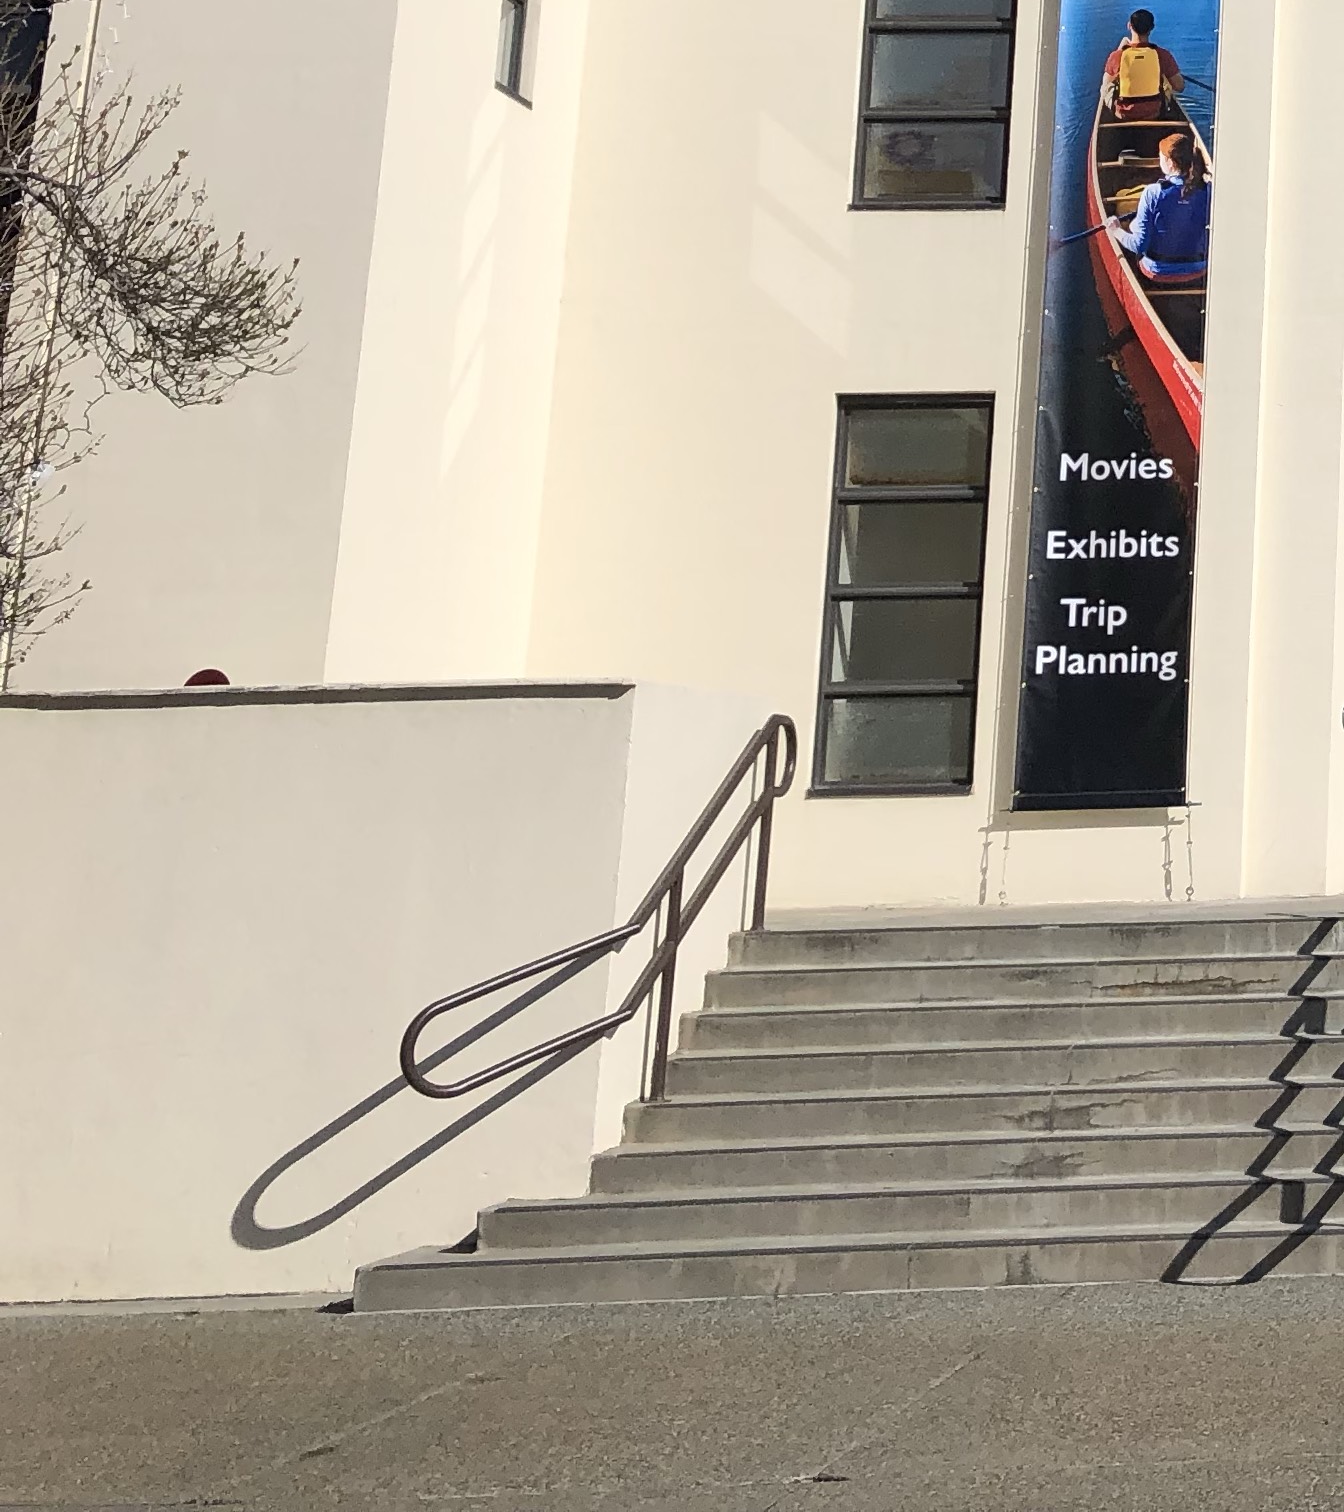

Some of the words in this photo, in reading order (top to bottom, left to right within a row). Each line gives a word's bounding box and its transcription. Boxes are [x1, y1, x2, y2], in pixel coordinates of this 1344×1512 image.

[1059, 452, 1174, 482] Movies
[1046, 529, 1180, 560] Exhibits
[1060, 597, 1128, 636] Trip
[1035, 645, 1179, 682] Planning
